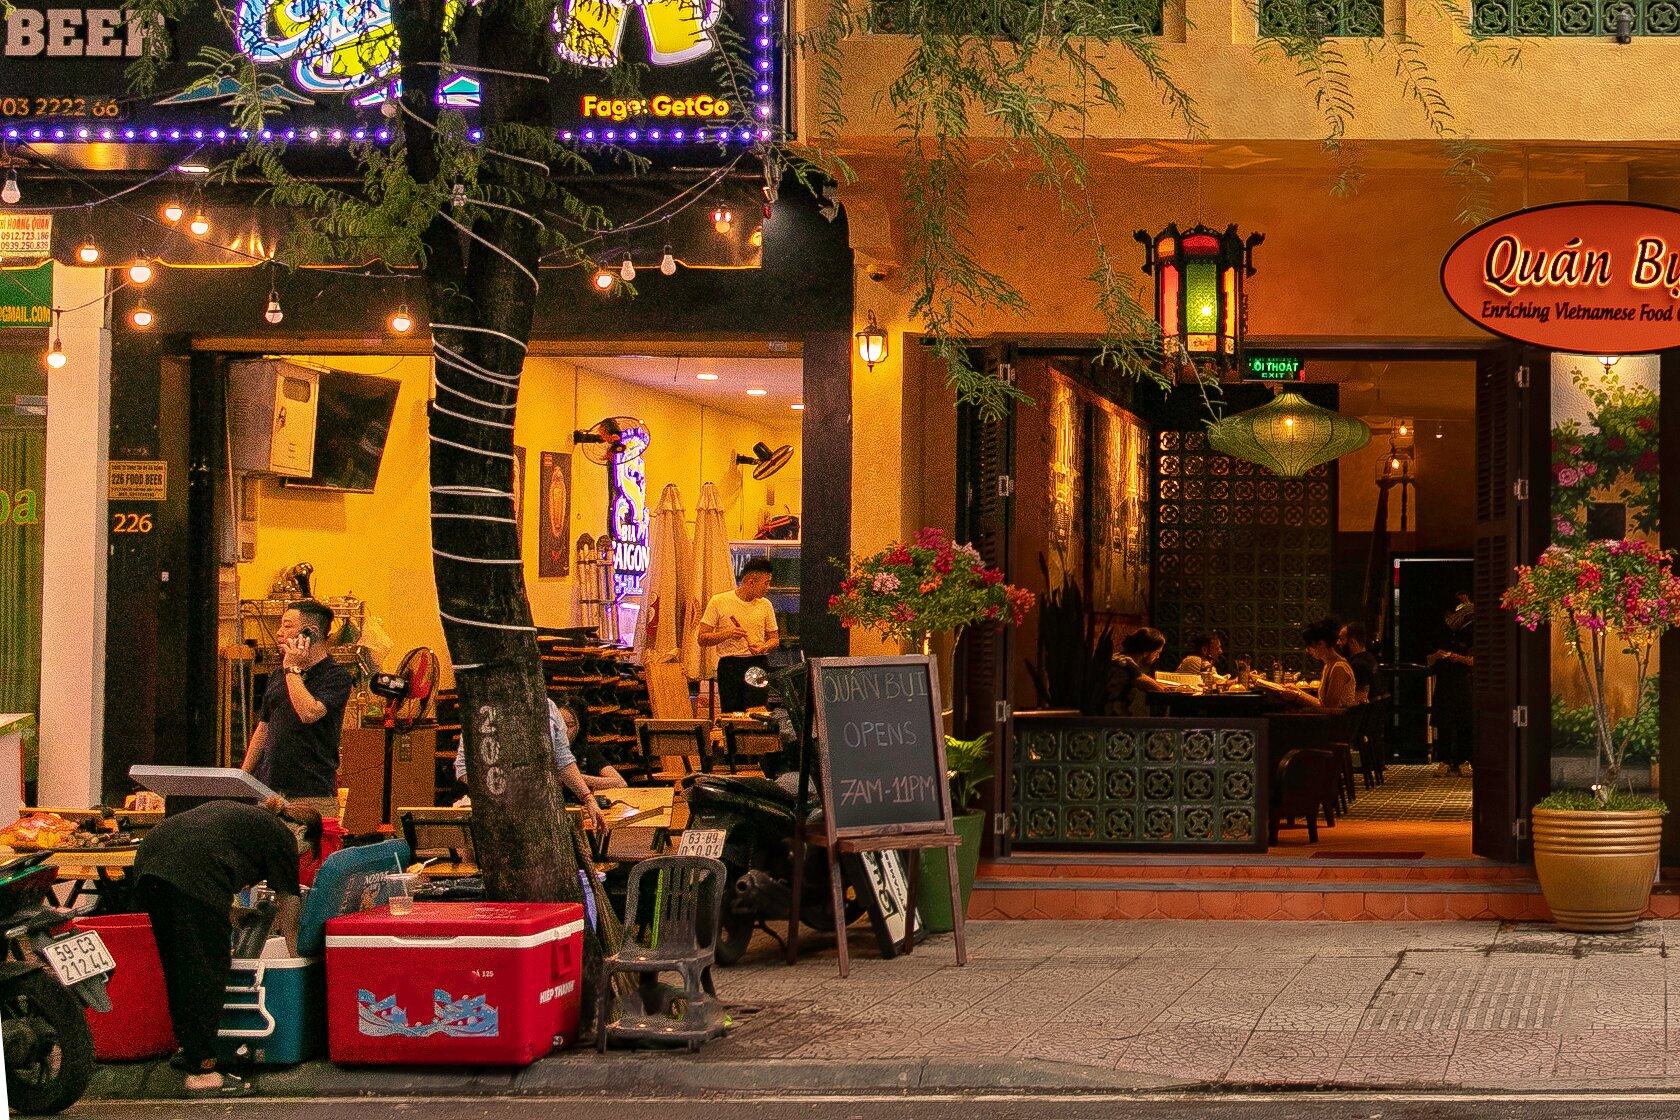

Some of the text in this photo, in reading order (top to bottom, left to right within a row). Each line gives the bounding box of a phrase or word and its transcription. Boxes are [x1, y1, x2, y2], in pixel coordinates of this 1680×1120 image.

[0, 97, 29, 116] 03
[35, 97, 87, 116] 2222
[652, 94, 731, 117] GetGo
[1484, 234, 1613, 297] Quán
[0, 305, 51, 323] GMAIL.COM
[1481, 300, 1551, 323] Enriching
[1555, 301, 1635, 322] Vietnamese
[1639, 304, 1674, 322] Food
[113, 513, 153, 533] 226
[824, 669, 881, 703] QUÁN
[843, 721, 917, 748] OPENS
[54, 936, 96, 961] 59-C3
